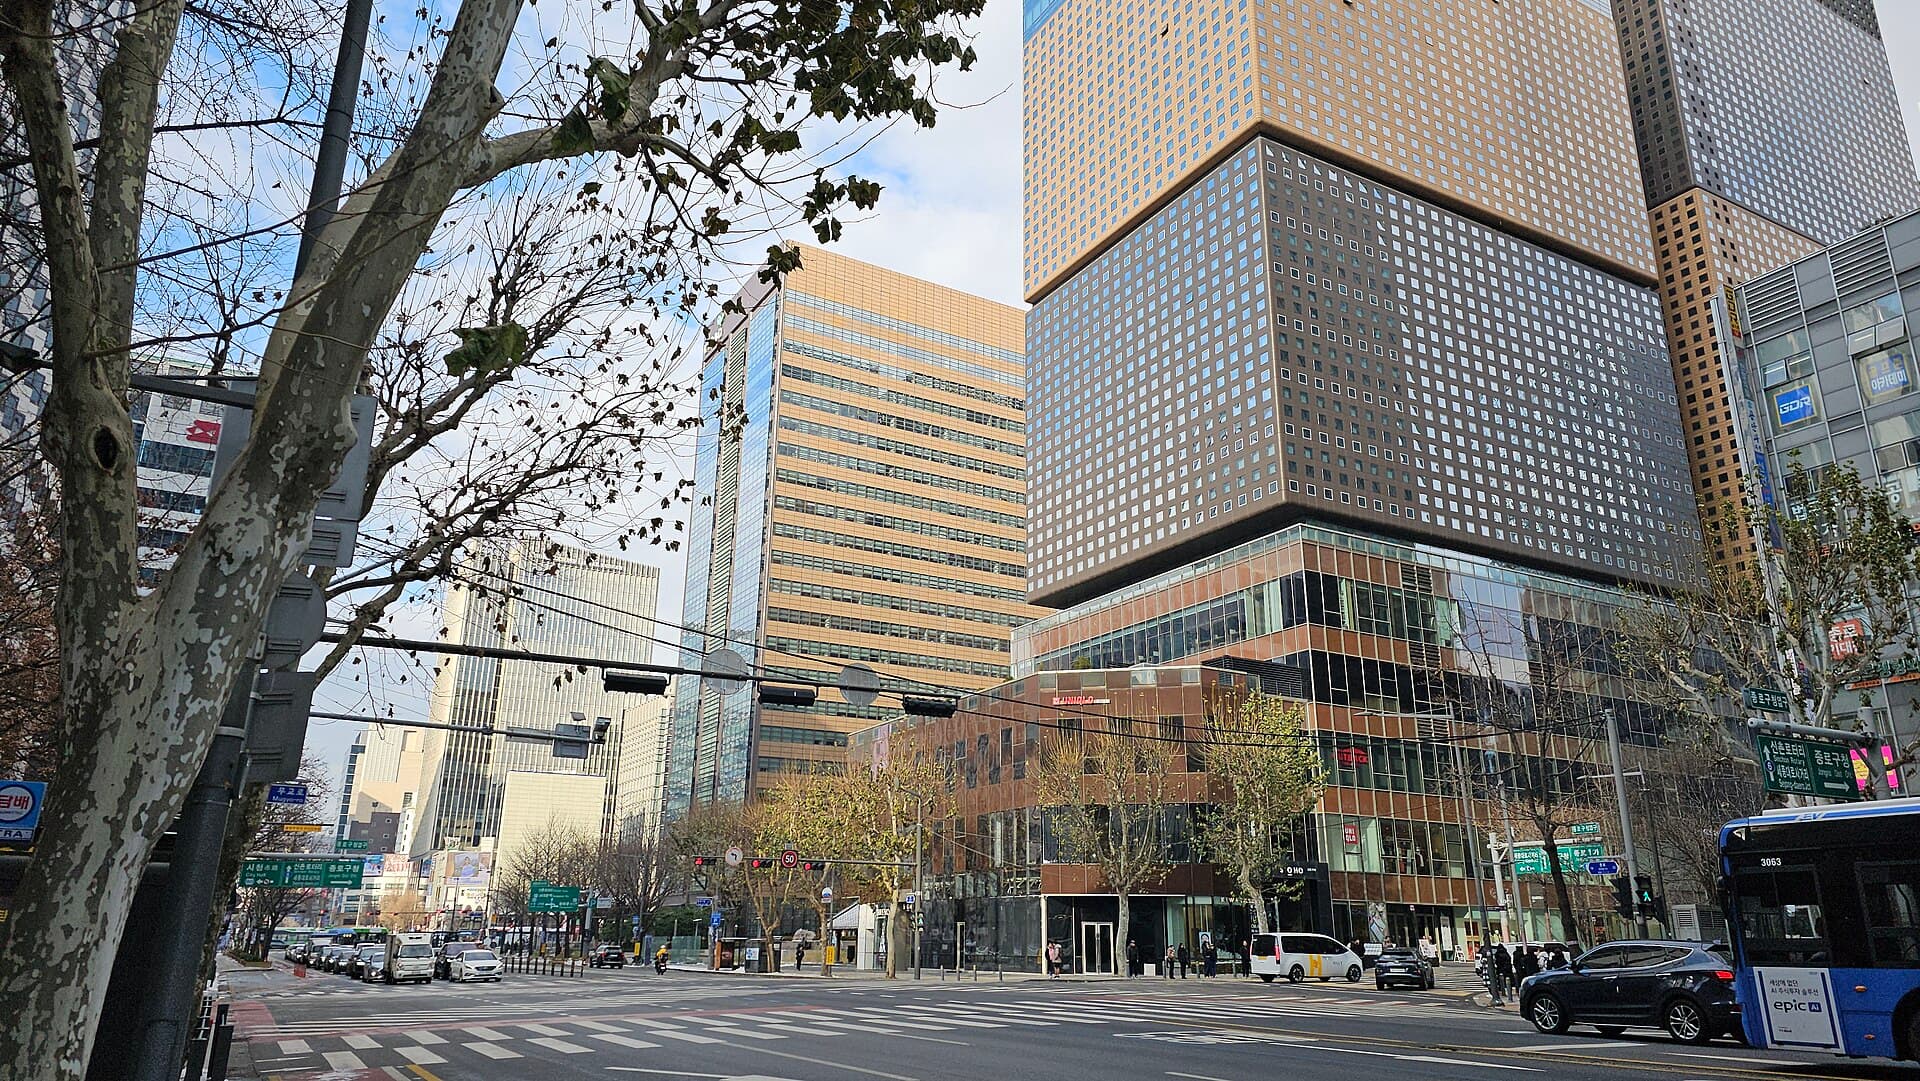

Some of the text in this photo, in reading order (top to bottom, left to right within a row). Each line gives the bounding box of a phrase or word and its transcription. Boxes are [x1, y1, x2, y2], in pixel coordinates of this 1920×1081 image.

[1871, 370, 1907, 391] 아카데미
[1779, 396, 1811, 415] GDR
[1063, 695, 1094, 705] UNIQLO
[1751, 691, 1788, 709] 종로구청입구
[1771, 740, 1806, 758] 신촌로터리
[1814, 749, 1850, 769] 종로구청
[277, 786, 305, 796] 무교로
[784, 855, 794, 863] 50
[1760, 857, 1782, 867] 3063
[328, 864, 360, 873] 종로구청
[1773, 999, 1807, 1013] epic
